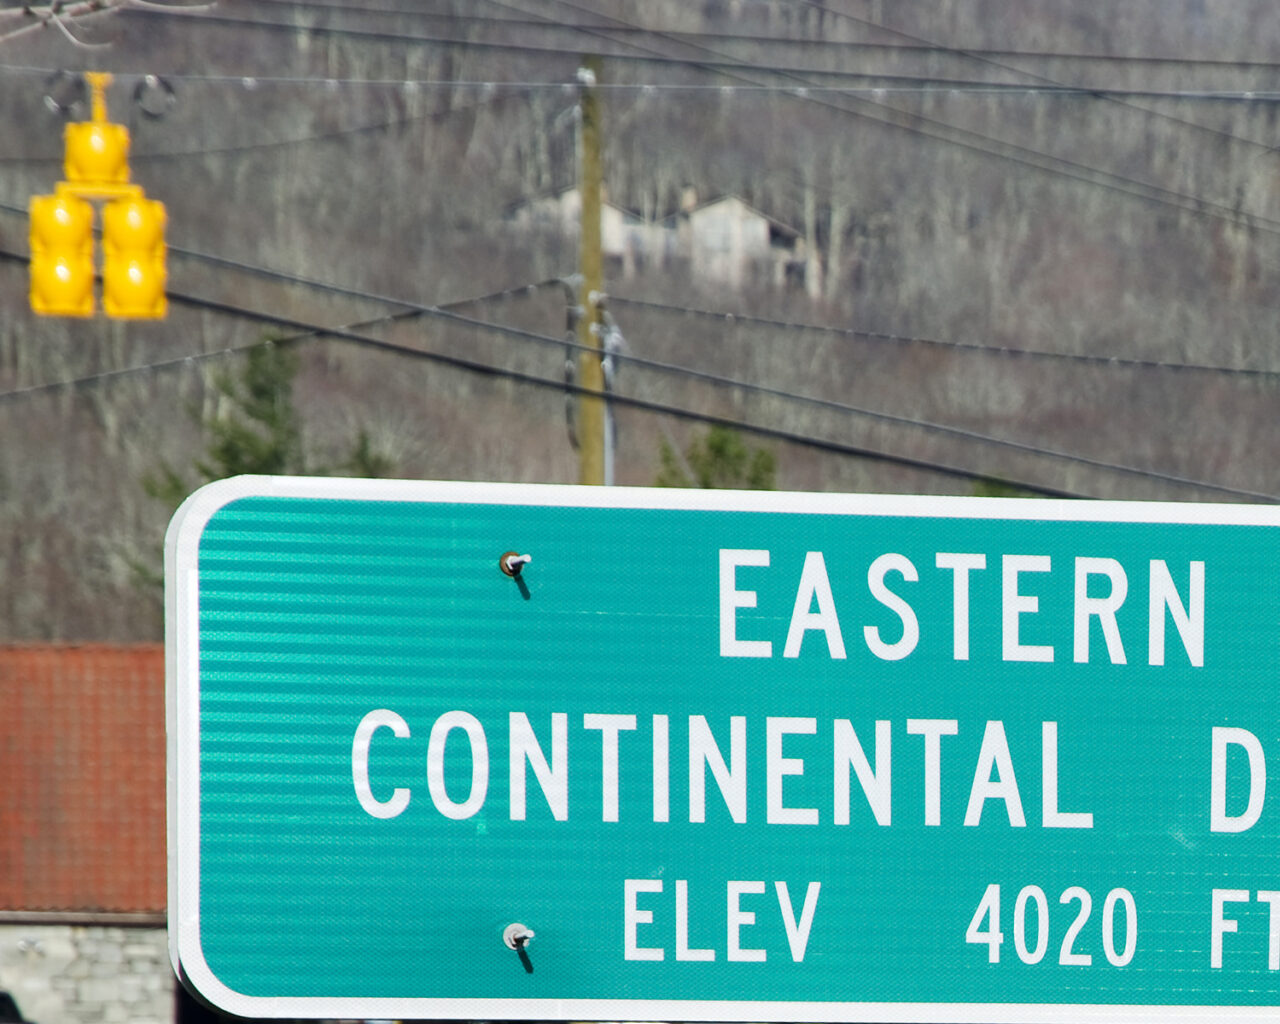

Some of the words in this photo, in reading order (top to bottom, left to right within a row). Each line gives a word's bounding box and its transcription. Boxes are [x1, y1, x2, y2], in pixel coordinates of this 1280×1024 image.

[720, 549, 1205, 668] EASTERN
[352, 709, 1094, 828] CONTINENTAL
[624, 879, 822, 963] ELEV
[966, 884, 1138, 967] 4020
